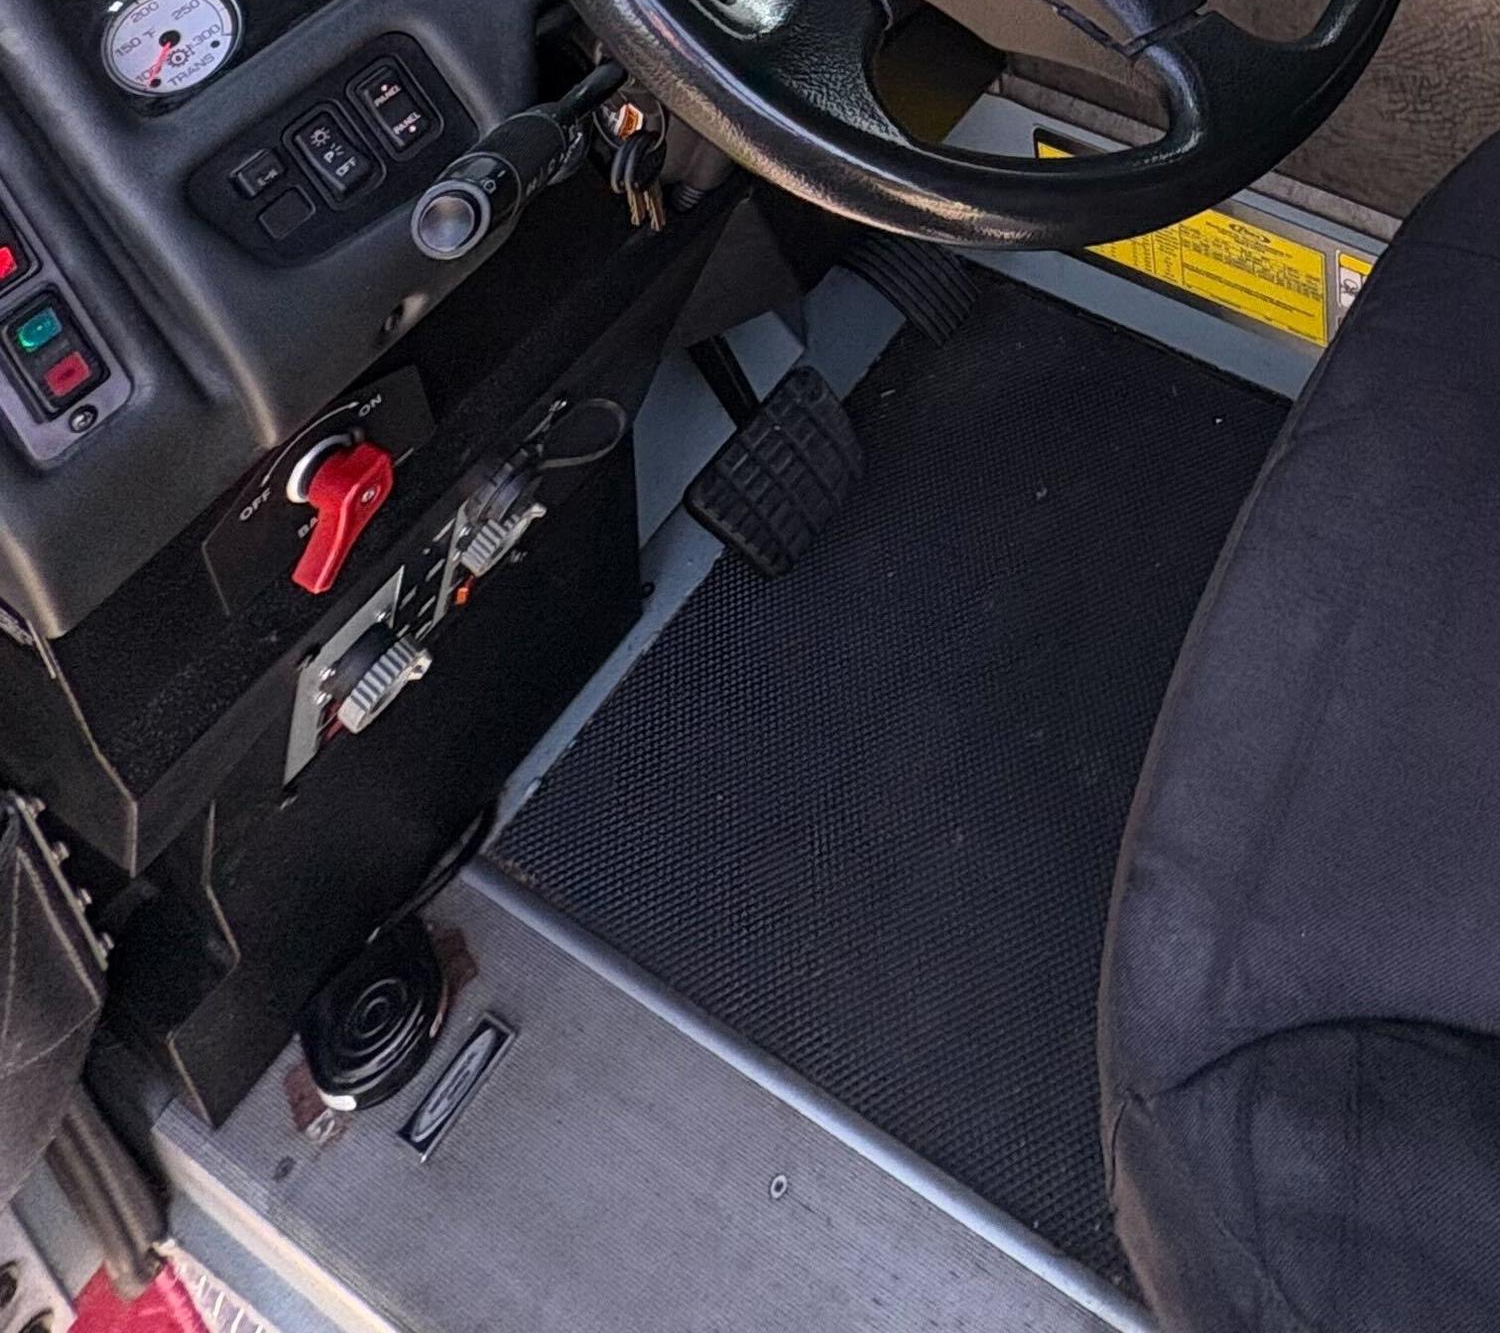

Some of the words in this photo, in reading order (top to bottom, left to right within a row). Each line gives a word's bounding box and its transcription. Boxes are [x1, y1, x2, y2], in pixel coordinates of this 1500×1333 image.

[130, 1, 159, 23] 200
[114, 36, 142, 58] 150
[192, 24, 221, 47] 300
[167, 51, 216, 87] TRANS
[335, 156, 357, 177] OFF
[358, 394, 382, 417] ON
[239, 487, 271, 521] OFF
